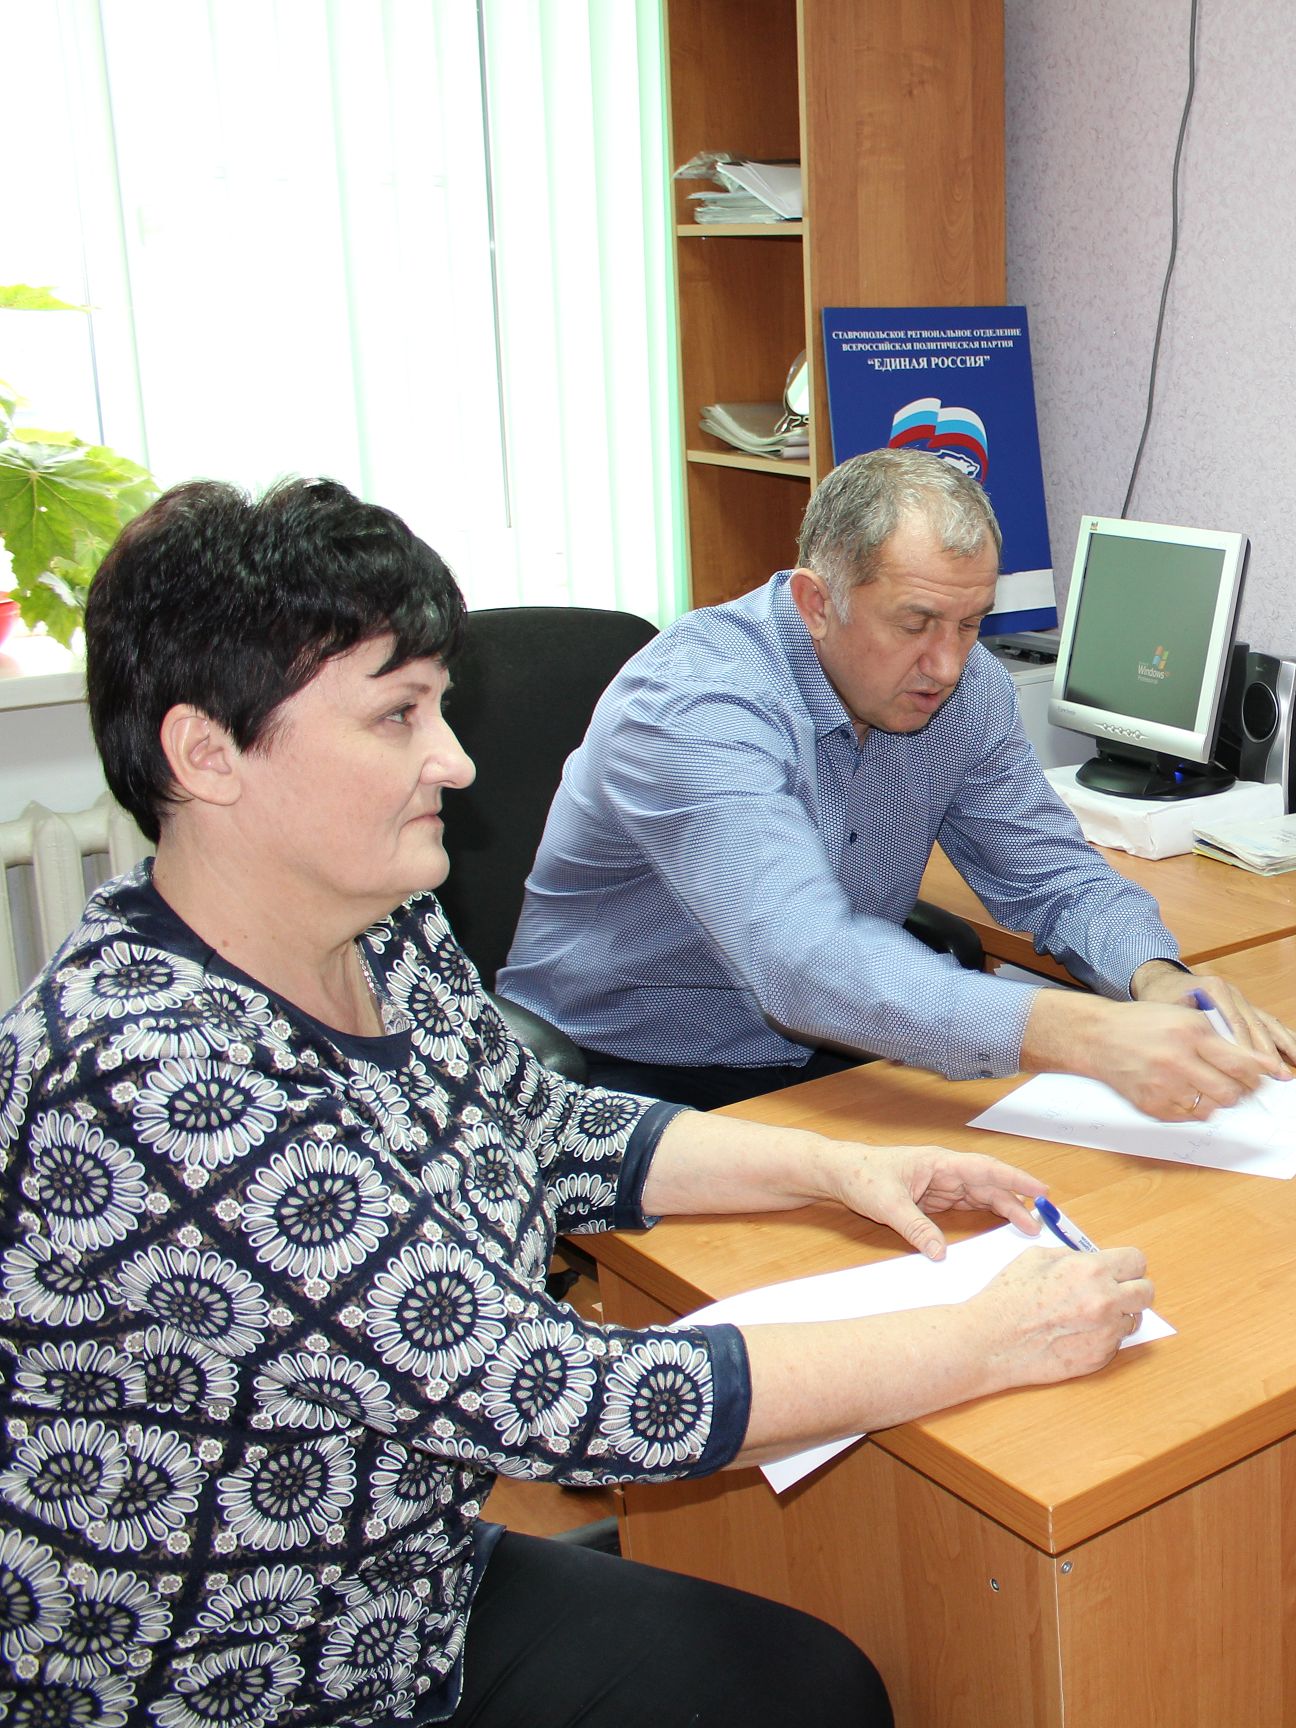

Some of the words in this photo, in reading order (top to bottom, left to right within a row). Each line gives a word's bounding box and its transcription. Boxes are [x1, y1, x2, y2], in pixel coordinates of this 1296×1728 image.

[832, 331, 906, 340] СТАВРОПОЛЬСКОЕ
[907, 329, 972, 339] РЕГИОНАЛЬНОЕ
[973, 328, 1022, 338] ОТДЕЛЕНИЕ
[842, 341, 912, 351] ВСЕРОССИЙСКАЯ
[913, 341, 980, 350] ПОЛИТИЧЕСКАЯ
[980, 340, 1014, 349] ПАРТИЯ
[1137, 664, 1165, 680] Windows
